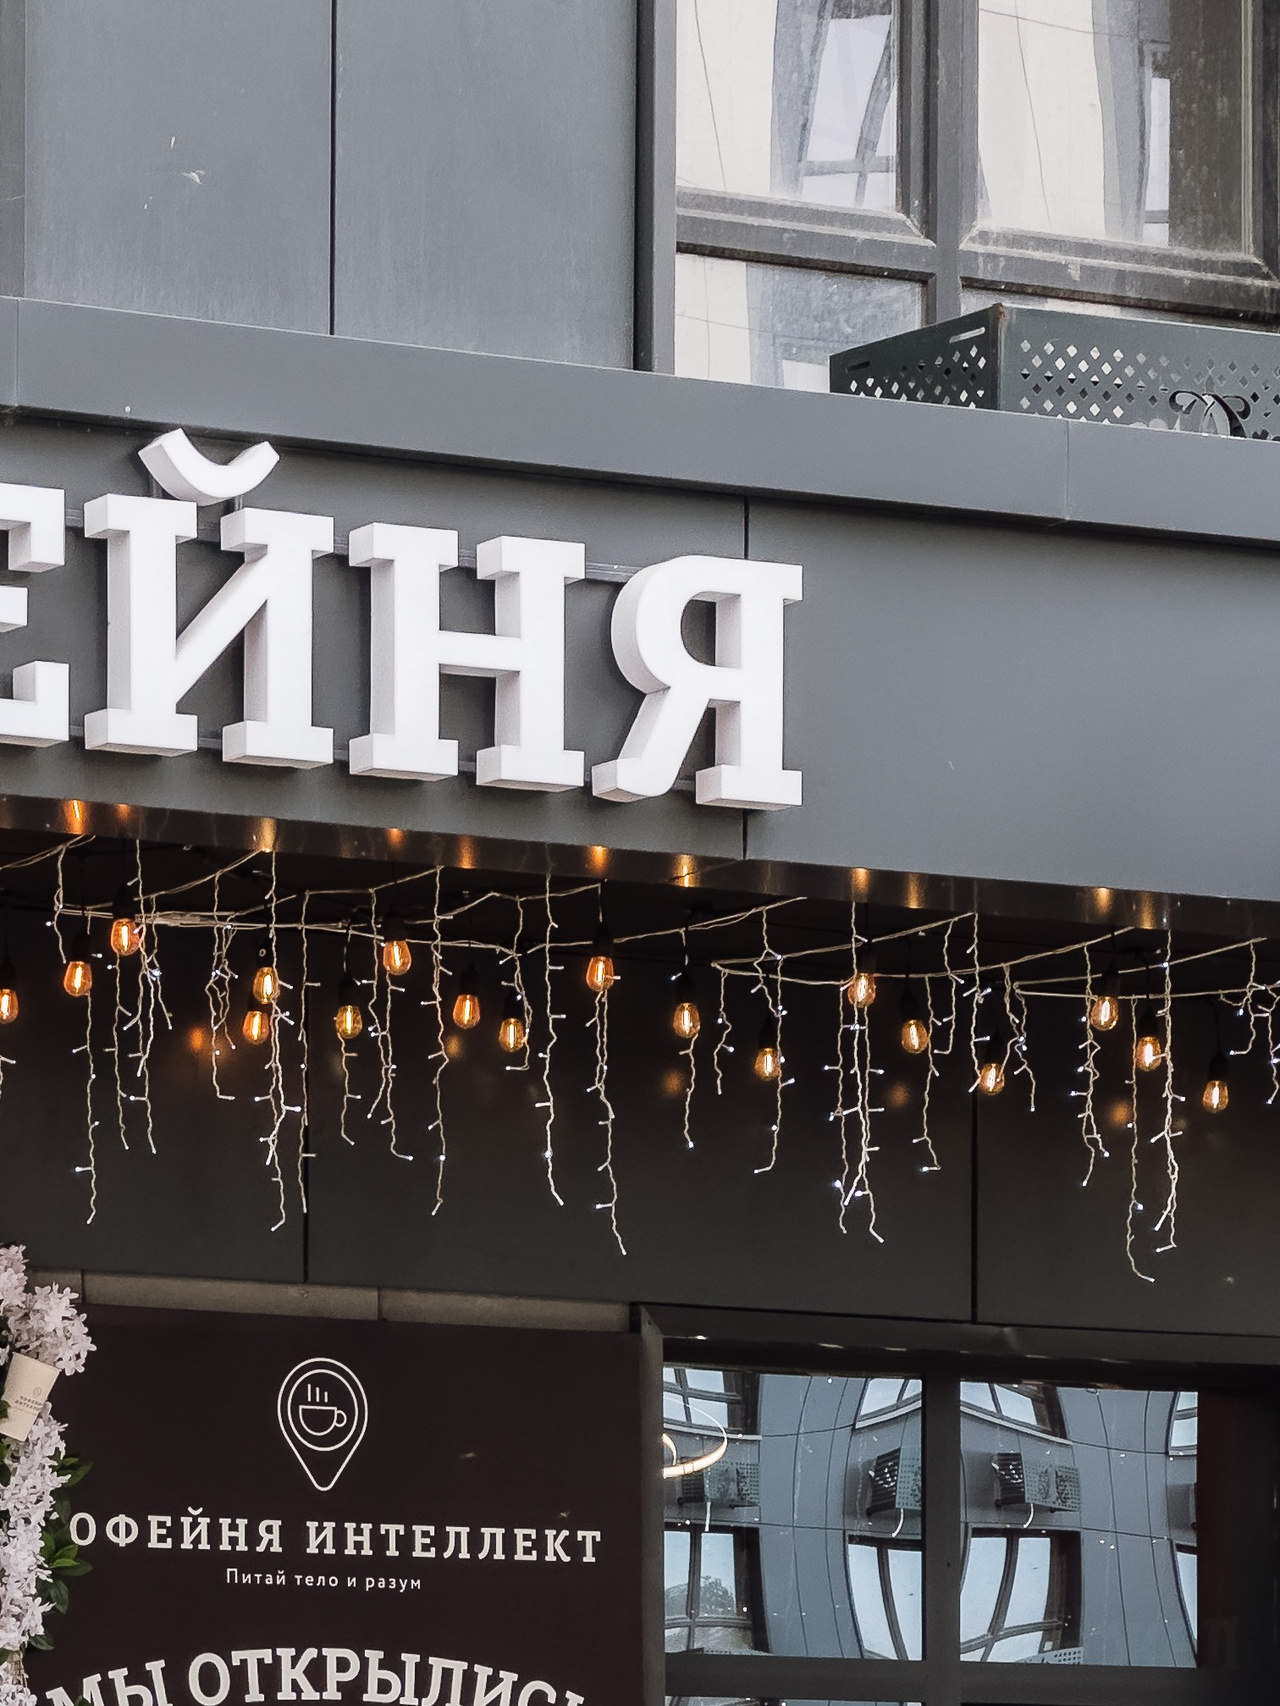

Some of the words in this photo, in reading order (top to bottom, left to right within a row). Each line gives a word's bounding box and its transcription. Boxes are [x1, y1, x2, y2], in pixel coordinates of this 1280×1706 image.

[70, 1507, 282, 1552] ОФЕЙНЯ
[306, 1520, 601, 1563] ИНТЕЛЛЕКТ
[227, 1568, 286, 1586] Питай
[295, 1575, 338, 1587] тело
[348, 1577, 357, 1588] и
[366, 1578, 421, 1592] разум
